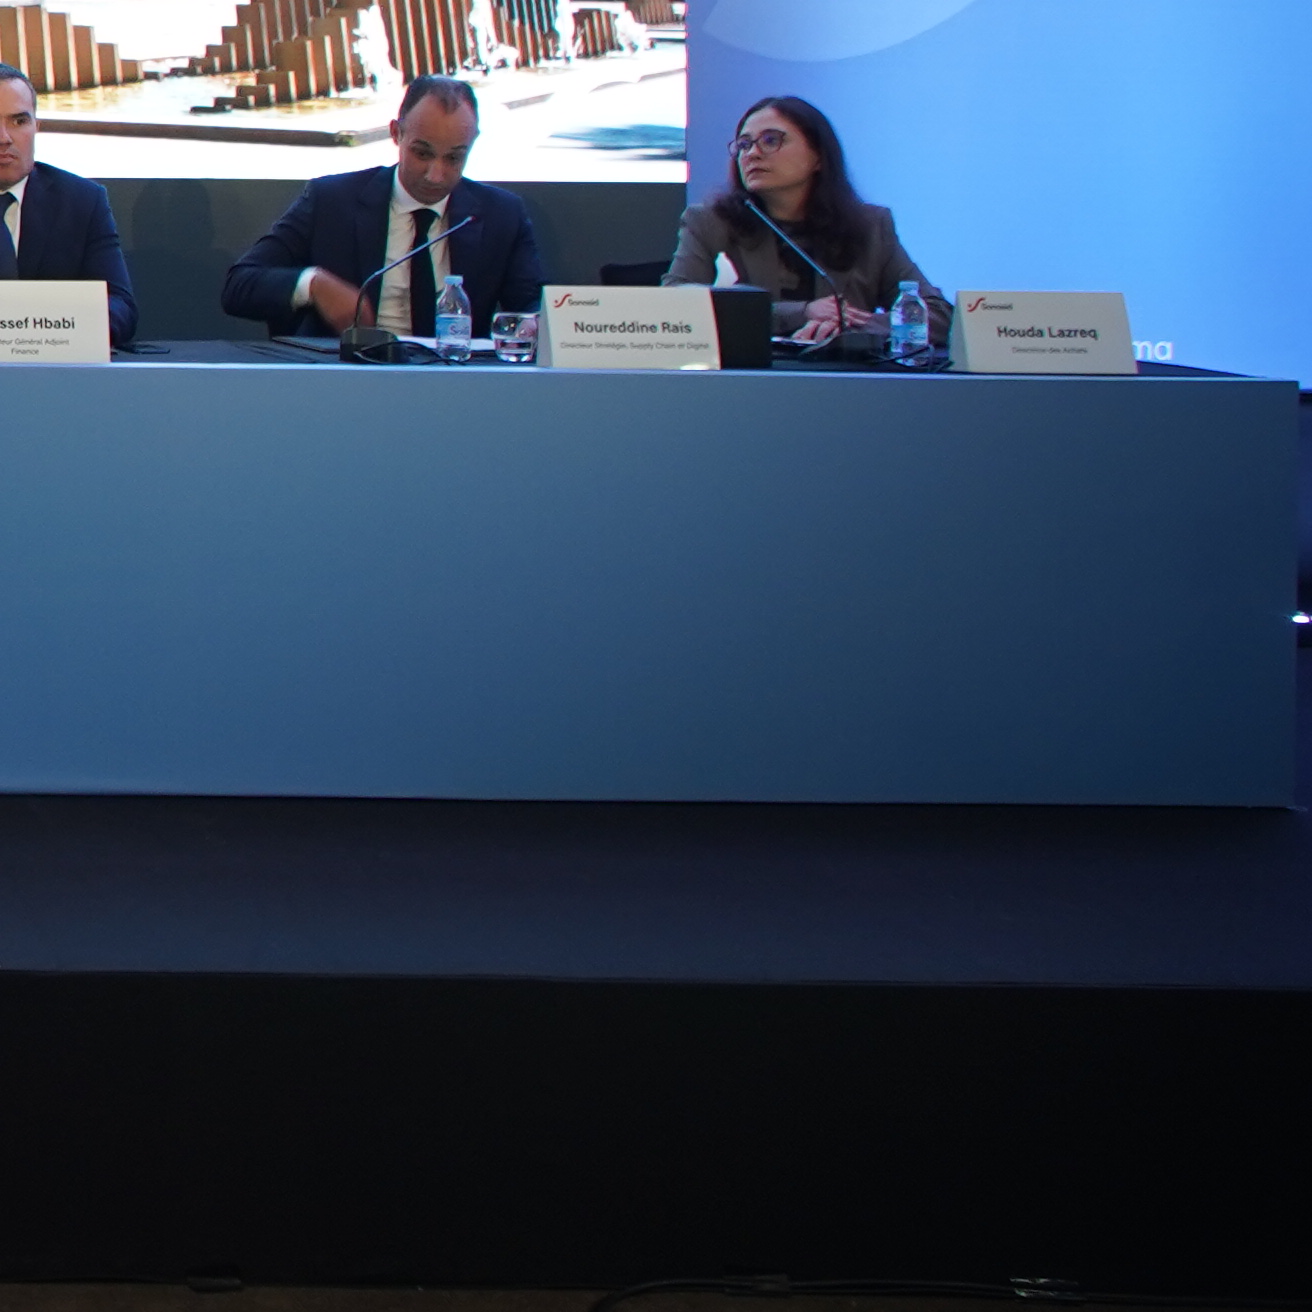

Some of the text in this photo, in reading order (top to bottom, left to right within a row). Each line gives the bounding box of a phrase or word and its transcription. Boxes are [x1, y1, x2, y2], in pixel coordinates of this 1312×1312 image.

[33, 317, 75, 329] Hbabi
[574, 321, 692, 334] Noureddine Rais
[997, 326, 1098, 340] Houda Lazreq
